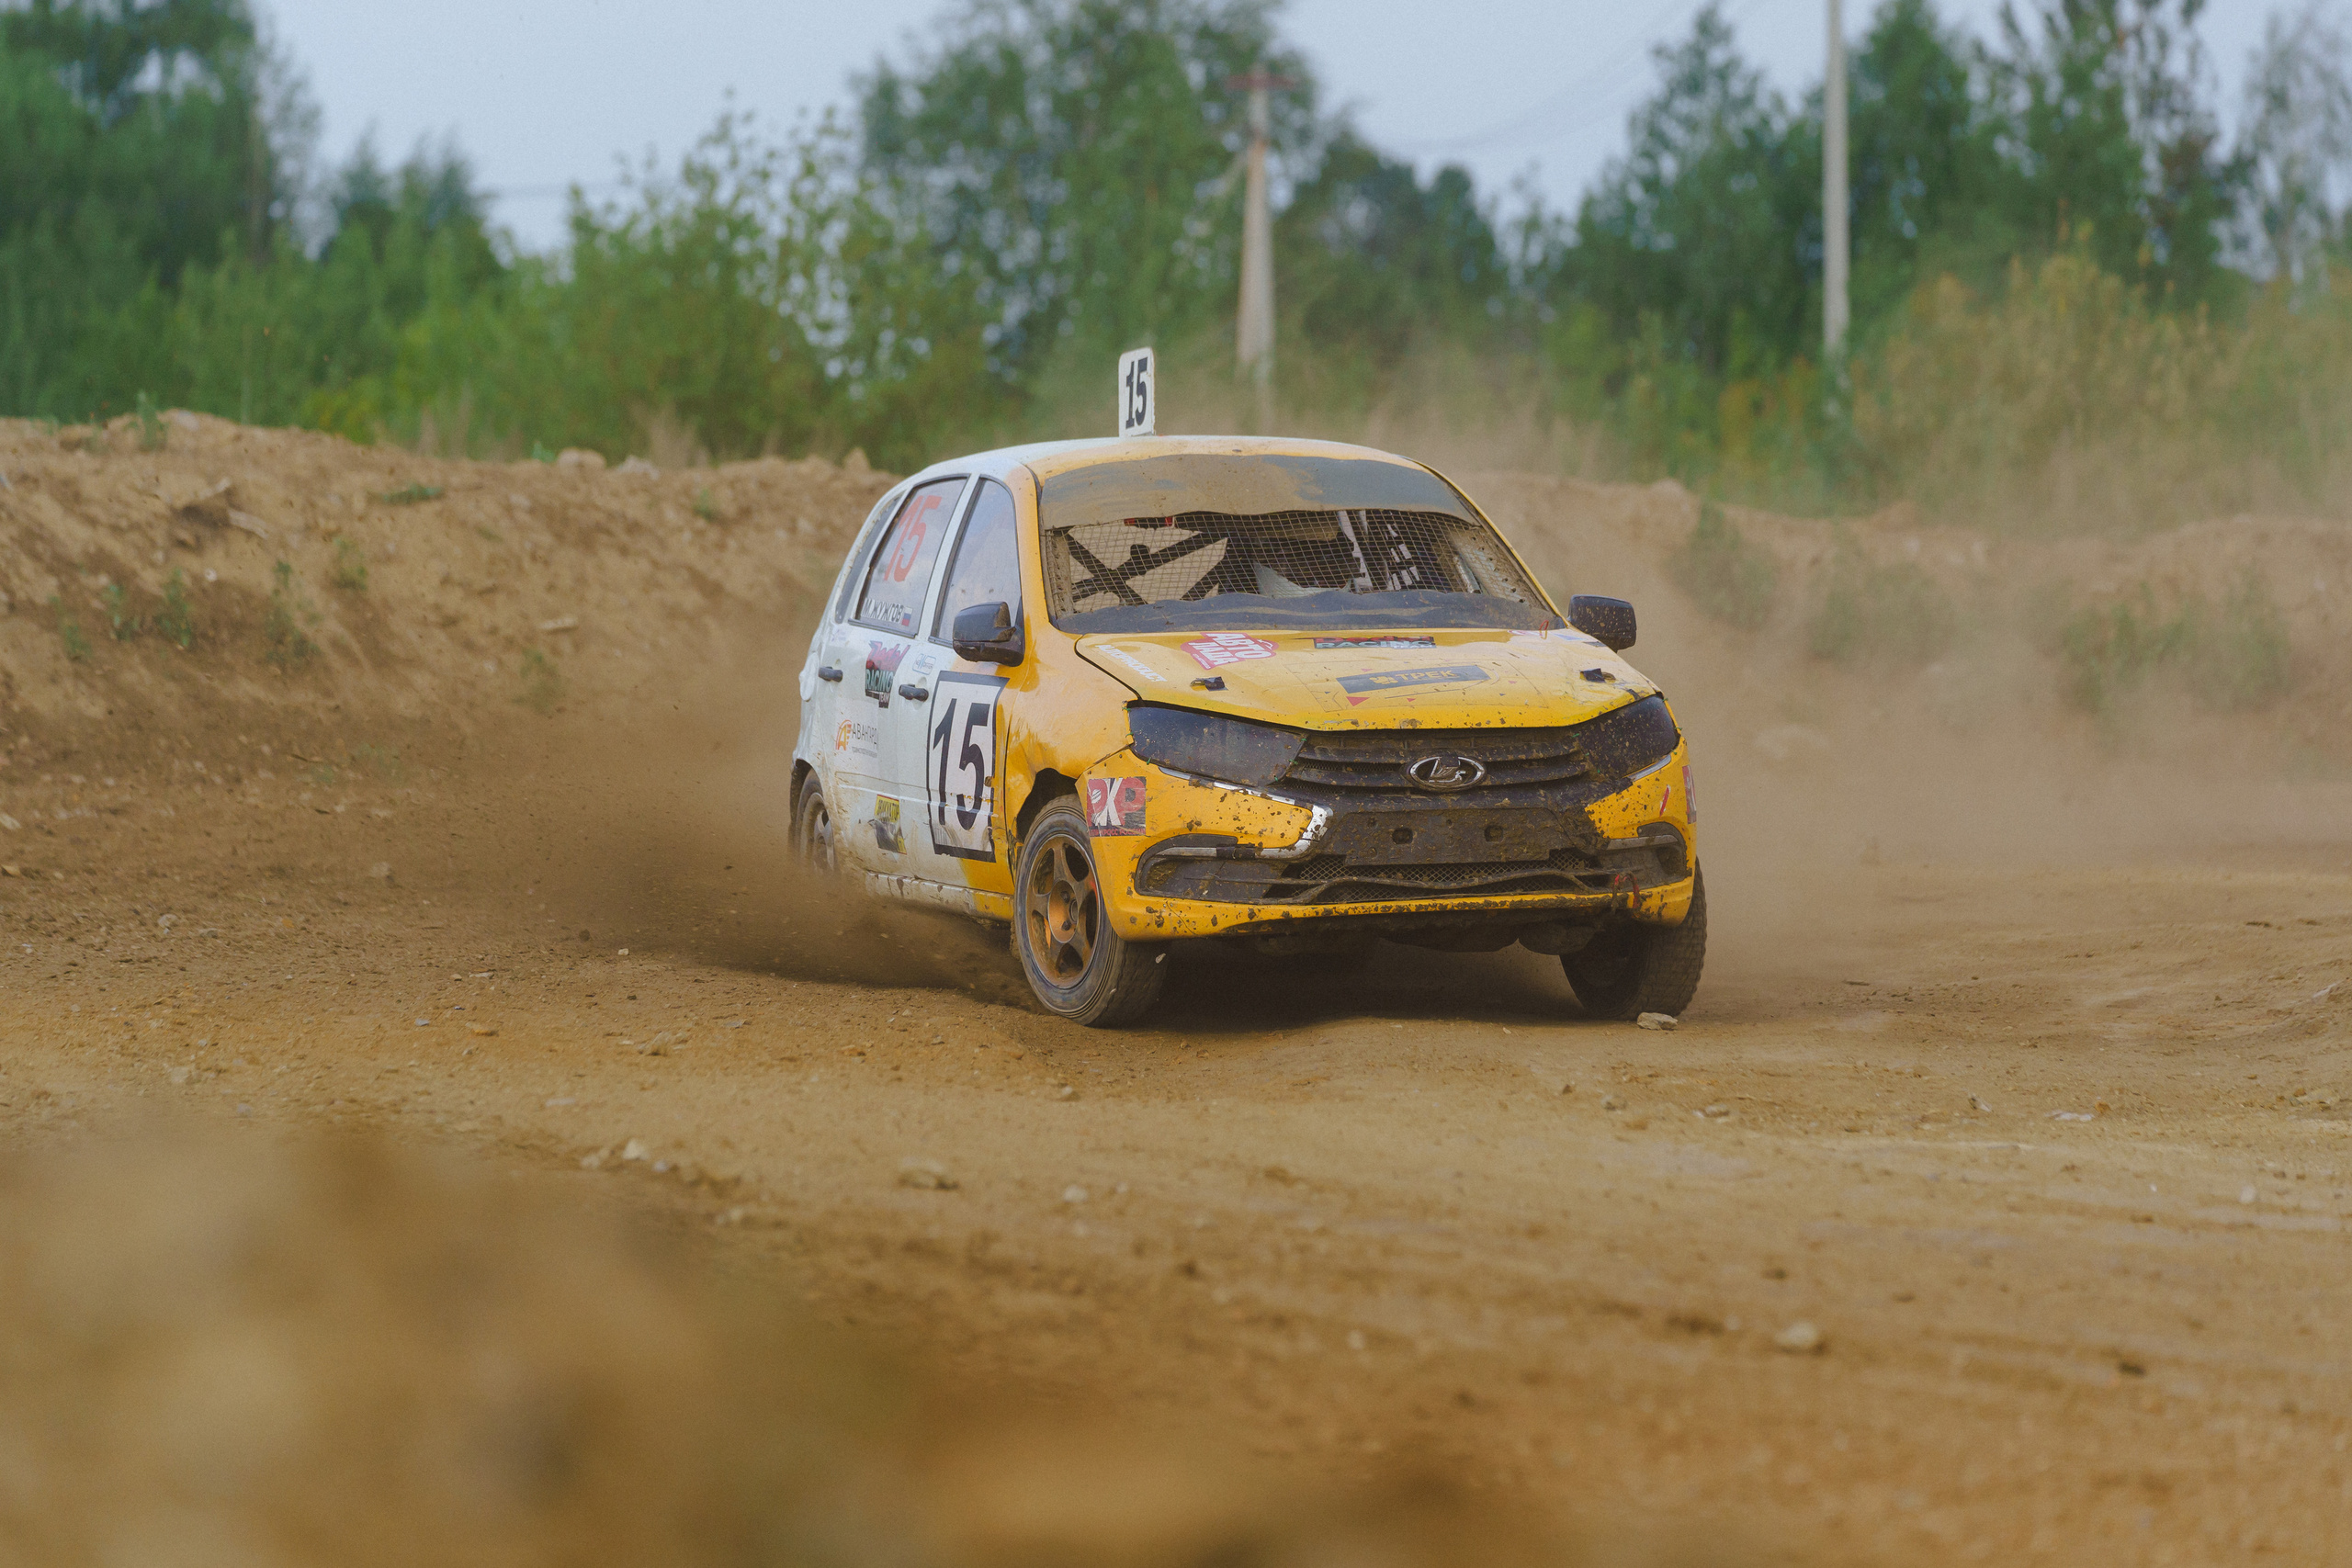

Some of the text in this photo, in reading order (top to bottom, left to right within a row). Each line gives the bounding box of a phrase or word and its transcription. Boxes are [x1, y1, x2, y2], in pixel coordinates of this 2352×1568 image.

[1125, 356, 1148, 429] 15
[884, 495, 942, 582] 15
[1206, 633, 1272, 659] АВТО
[1316, 640, 1433, 649] RACING
[865, 669, 894, 692] RACING
[1396, 671, 1455, 682] ТРЕК
[933, 698, 990, 830] 15
